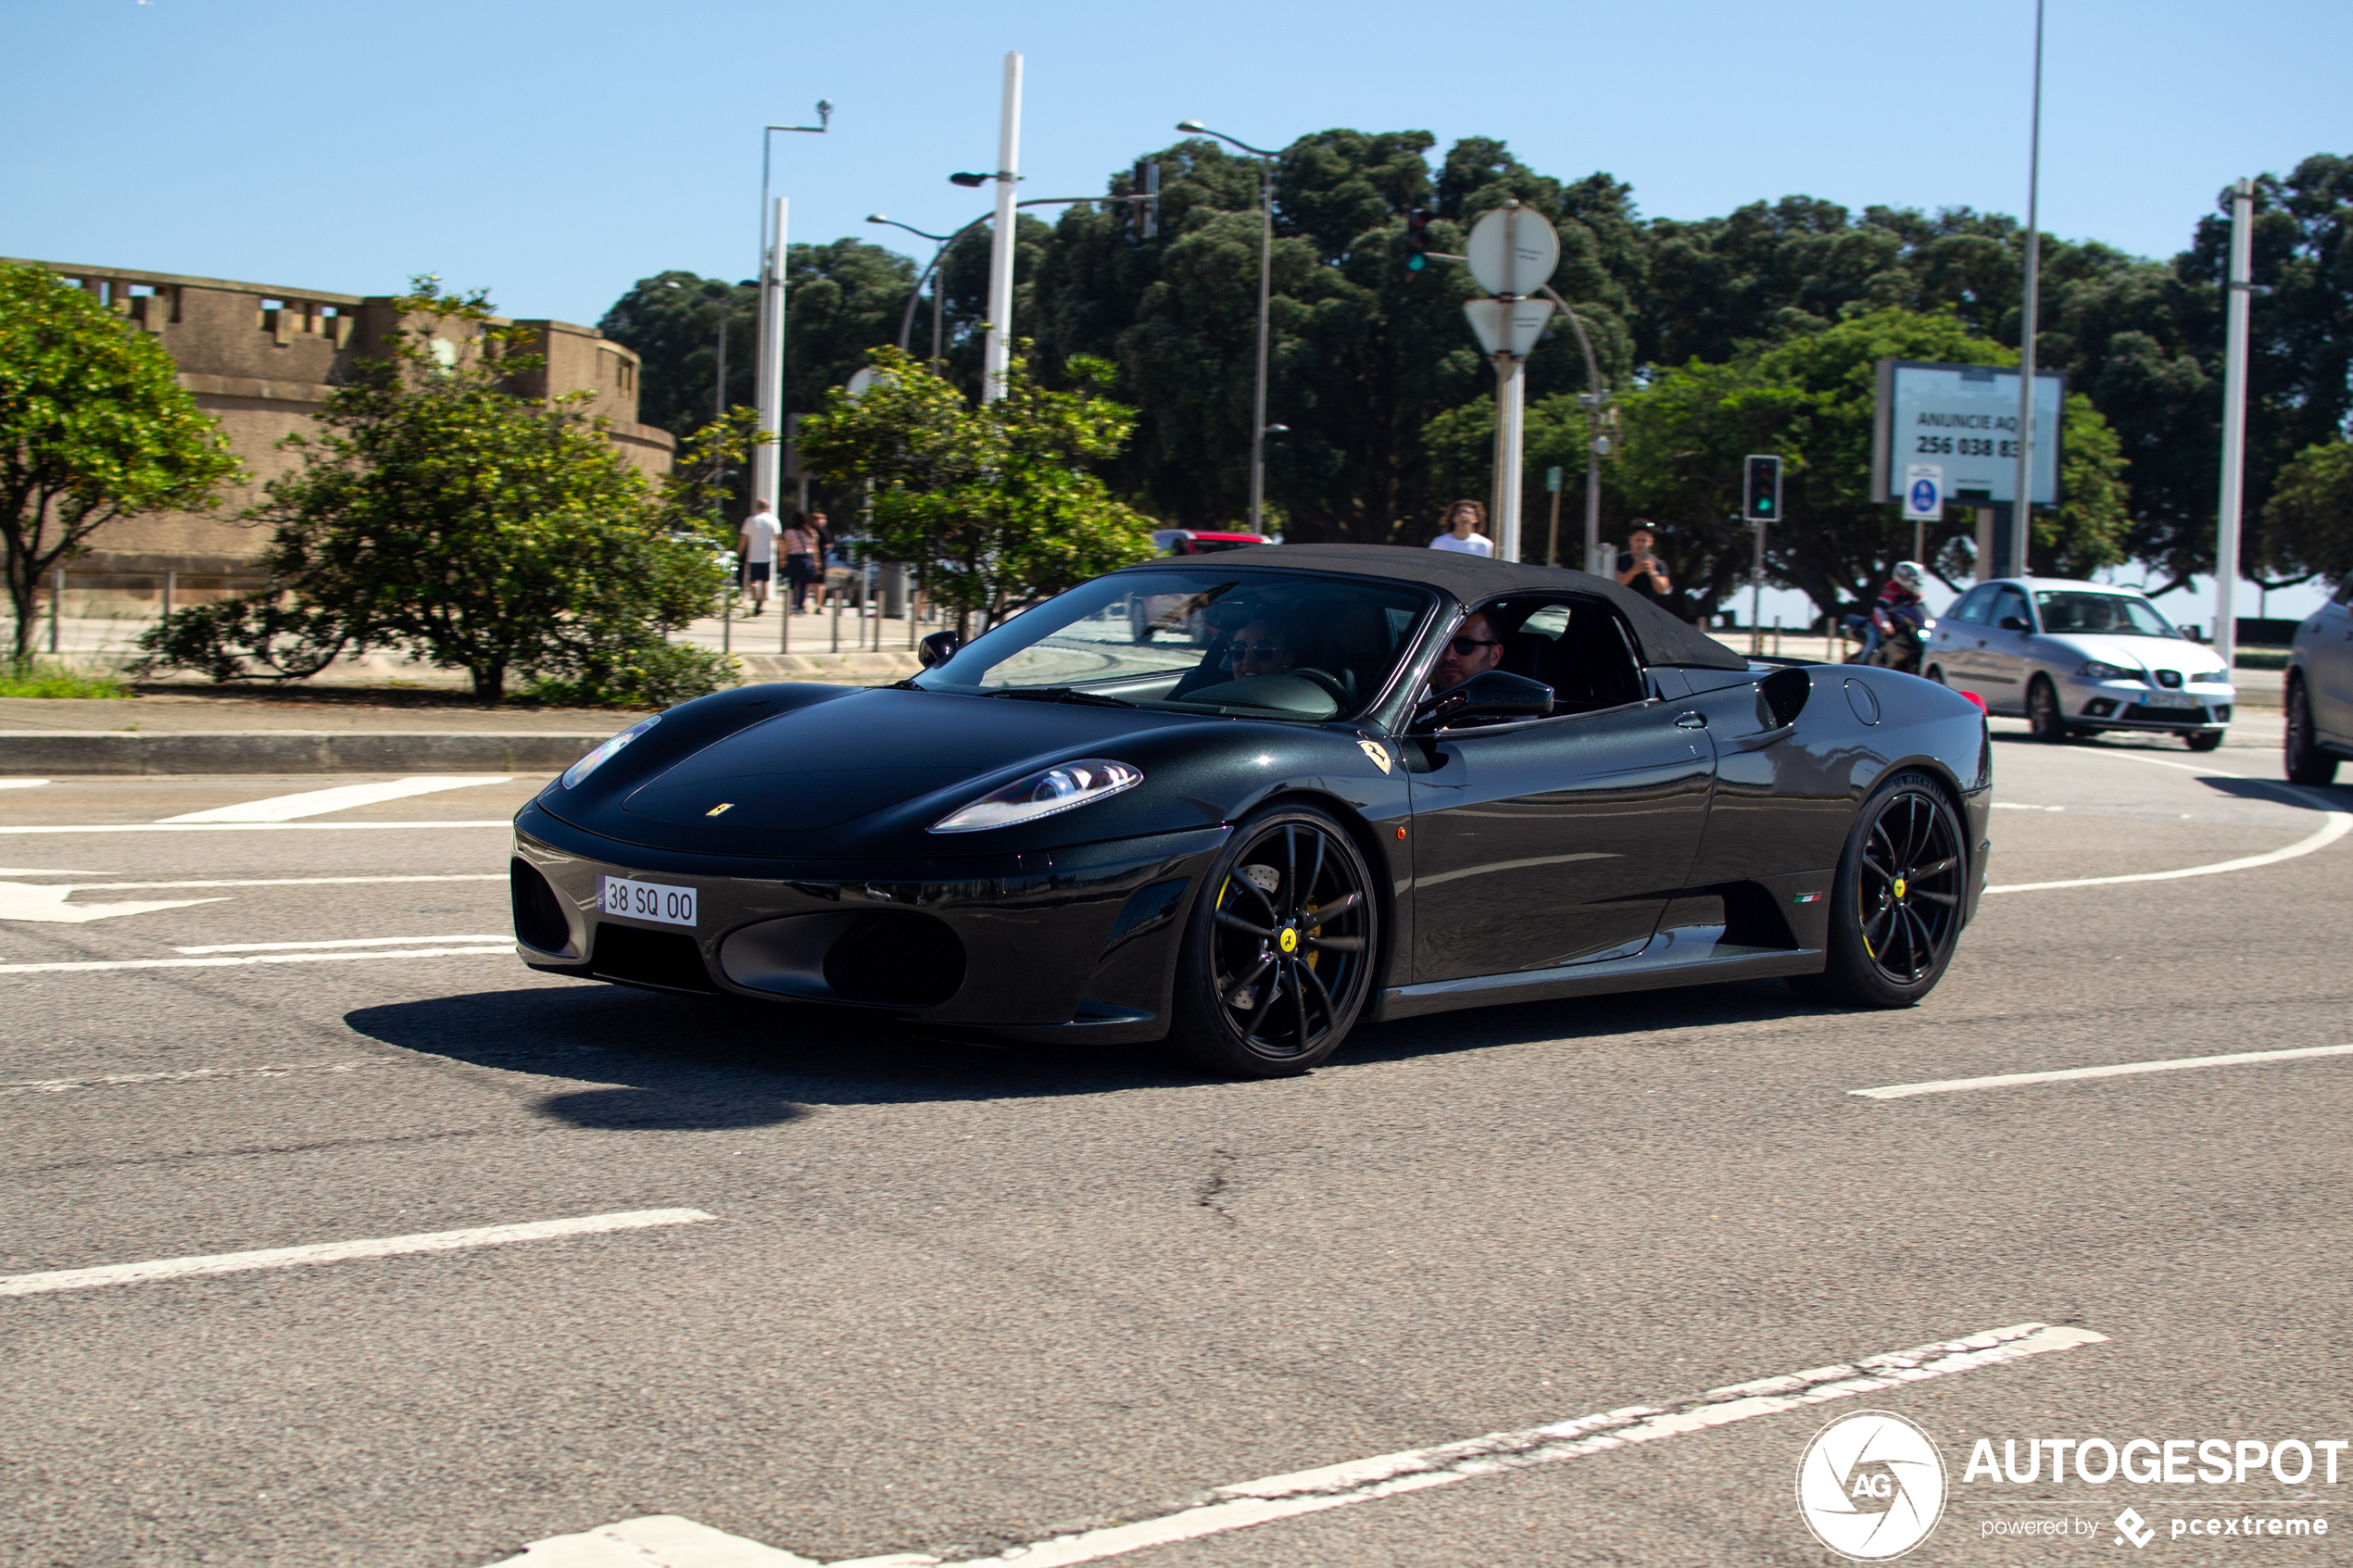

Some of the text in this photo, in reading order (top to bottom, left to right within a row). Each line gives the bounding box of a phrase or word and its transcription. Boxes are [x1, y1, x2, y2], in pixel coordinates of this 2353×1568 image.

[1917, 412, 2020, 434] ANUNCIE AQ
[1916, 435, 2020, 458] 256 038 83
[598, 897, 603, 908] P
[609, 883, 692, 921] 38 SQ 00
